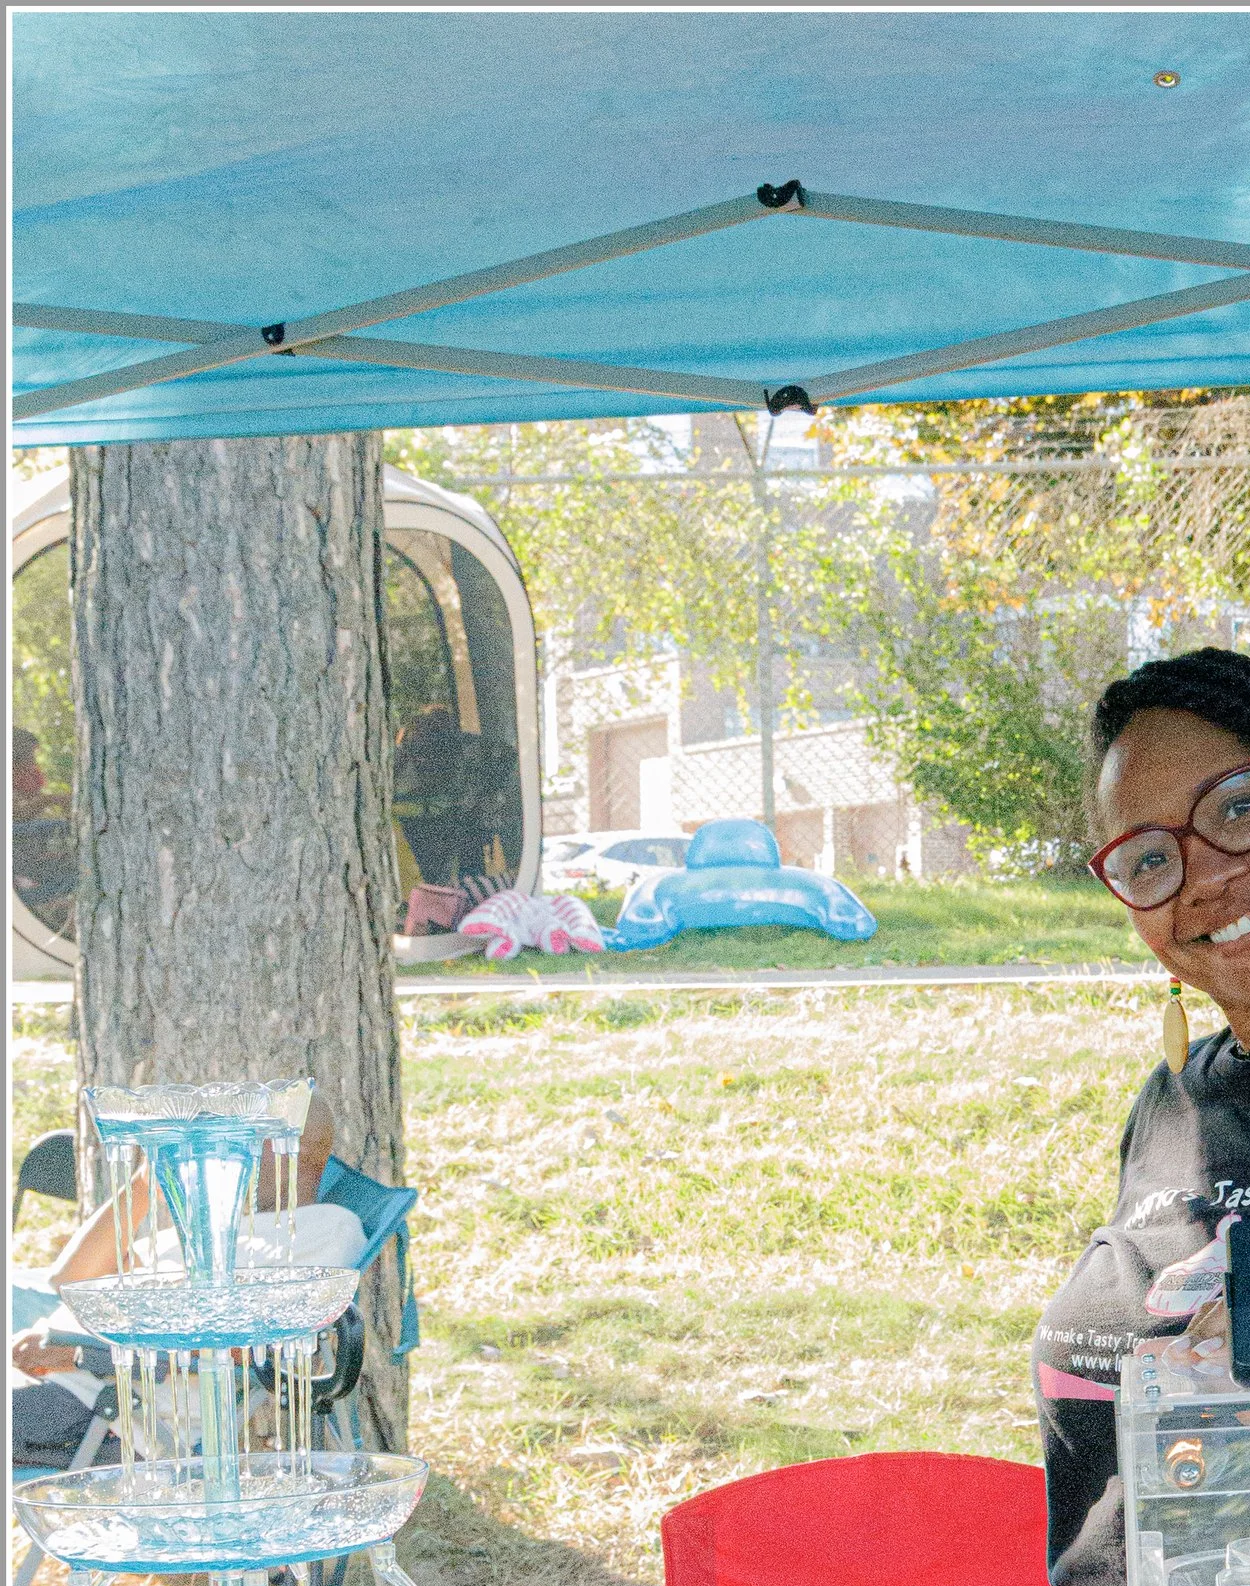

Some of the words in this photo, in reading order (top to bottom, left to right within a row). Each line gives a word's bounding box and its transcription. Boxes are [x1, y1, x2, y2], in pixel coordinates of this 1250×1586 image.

[1039, 1325, 1053, 1341] We
[1053, 1327, 1084, 1345] make
[1087, 1329, 1122, 1353] Tasty
